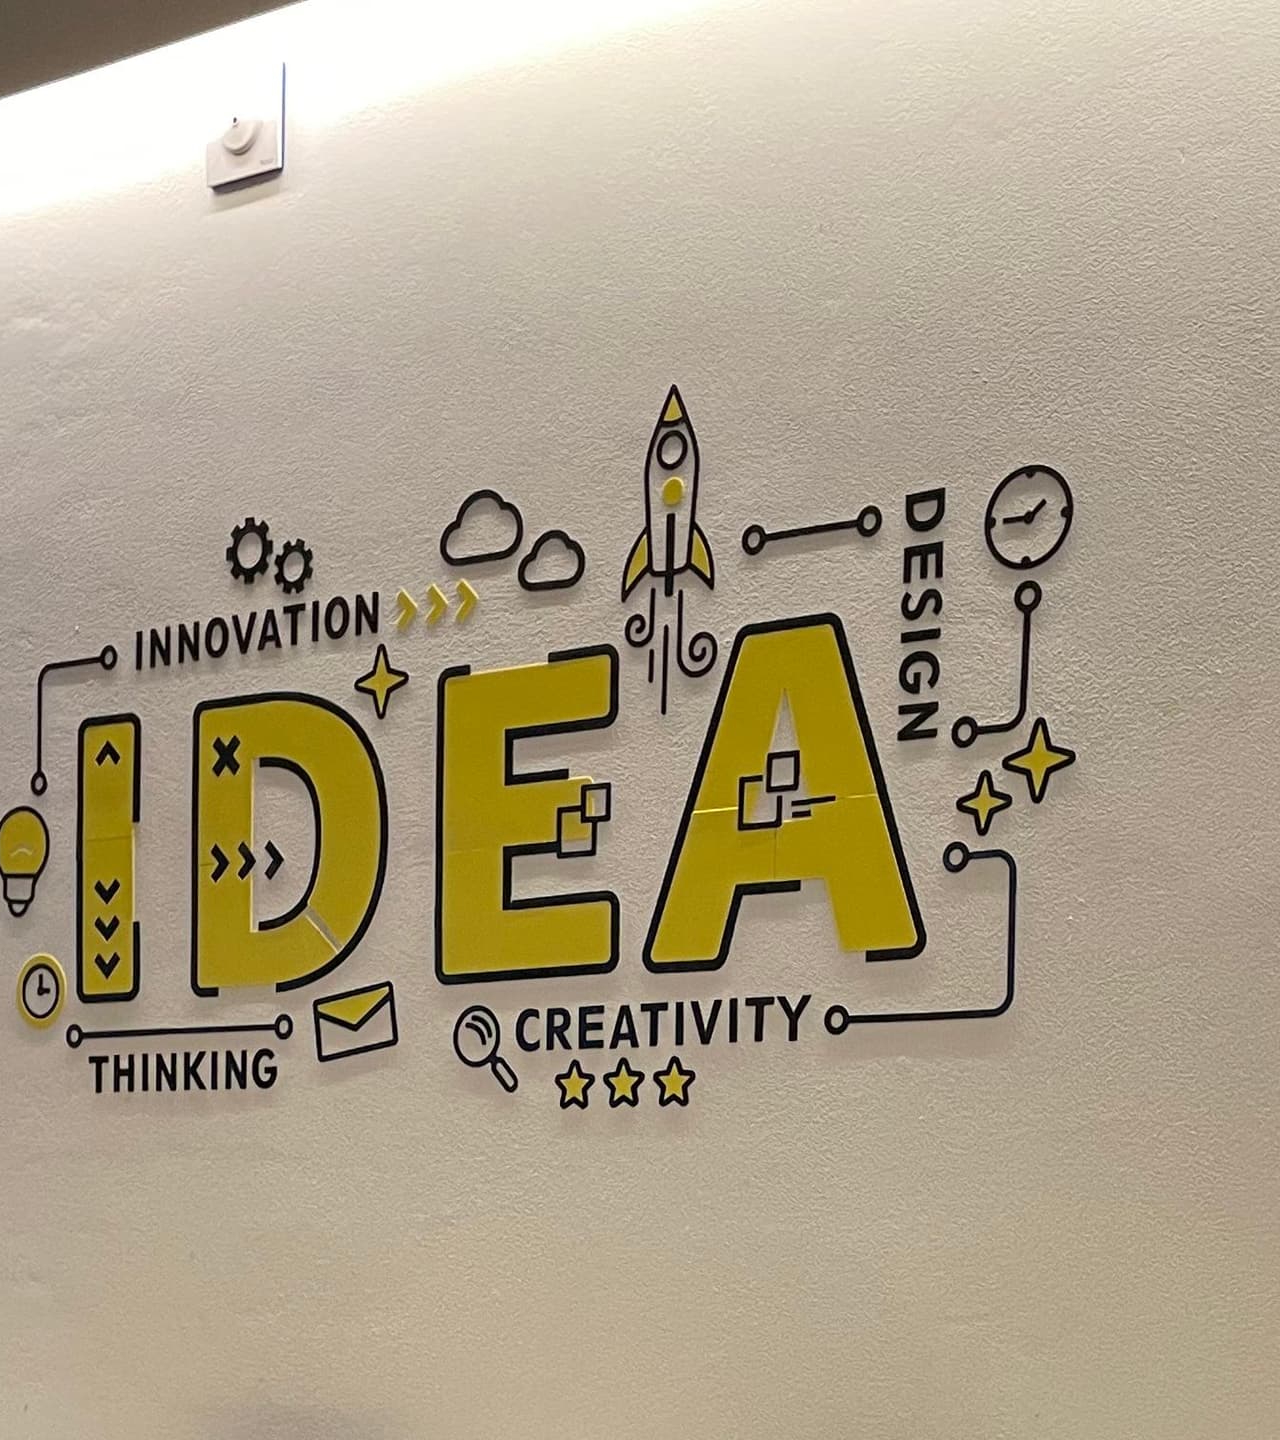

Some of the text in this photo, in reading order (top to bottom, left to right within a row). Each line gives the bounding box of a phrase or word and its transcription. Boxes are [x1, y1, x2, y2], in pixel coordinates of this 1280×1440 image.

[135, 593, 380, 671] INNOVATION
[897, 487, 946, 742] DESIGN
[76, 612, 927, 1003] IDEA
[515, 994, 812, 1052] CREATIVITY
[88, 1048, 278, 1094] THINKING
